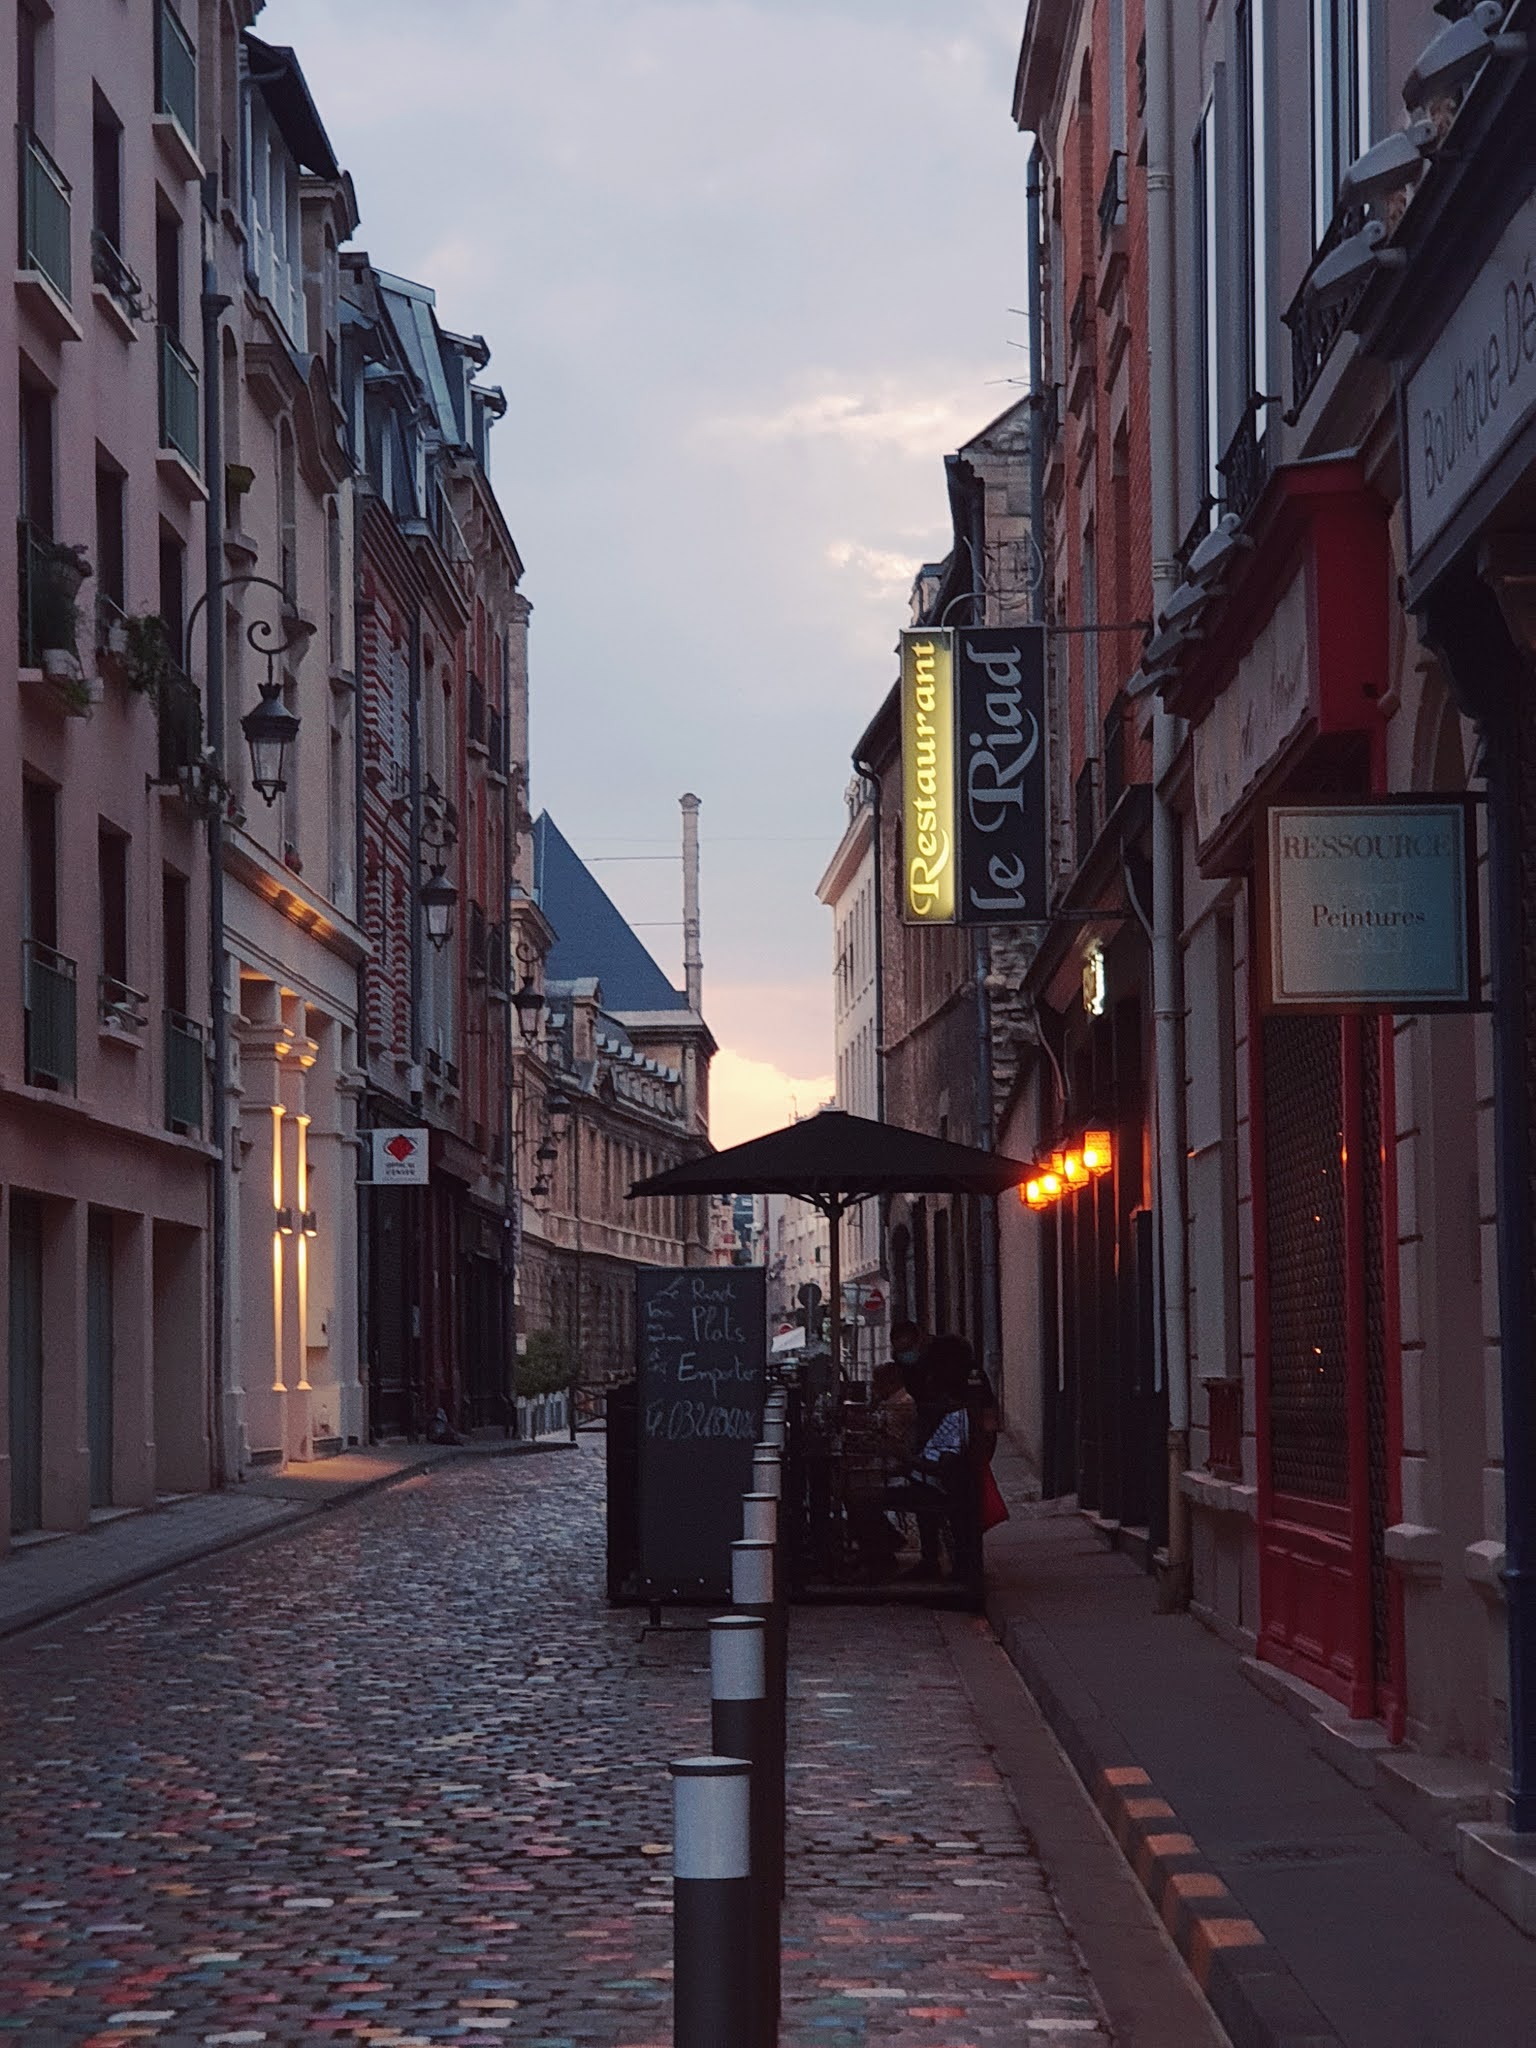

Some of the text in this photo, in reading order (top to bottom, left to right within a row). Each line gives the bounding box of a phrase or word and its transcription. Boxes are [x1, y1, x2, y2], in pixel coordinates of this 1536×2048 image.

[1423, 332, 1501, 499] Boutique
[909, 640, 951, 916] Restaurant
[965, 639, 1040, 834] Riad
[1283, 834, 1452, 860] RESSOURCE
[1312, 904, 1426, 928] Peintures
[691, 1306, 746, 1342] Plats
